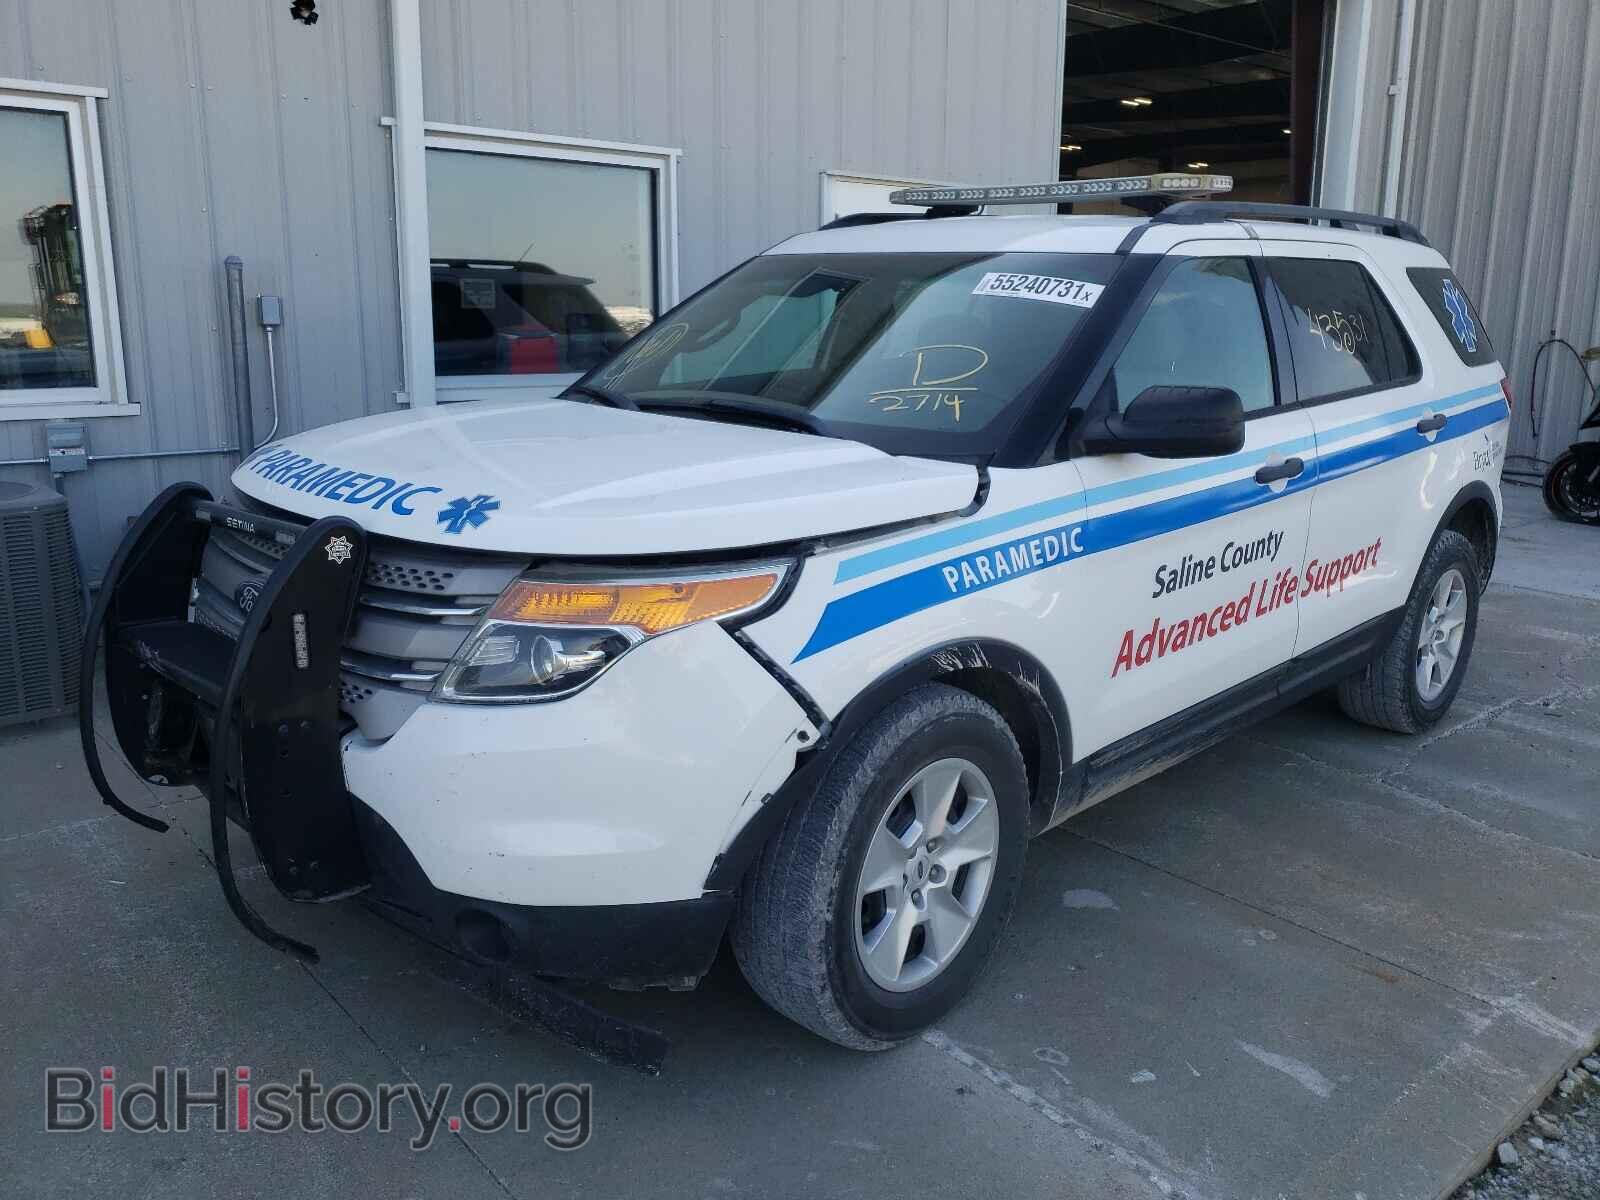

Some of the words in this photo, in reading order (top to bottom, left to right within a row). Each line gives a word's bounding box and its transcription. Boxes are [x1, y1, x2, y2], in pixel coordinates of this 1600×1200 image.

[249, 448, 442, 515] PARAMEDIC
[942, 527, 1084, 593] PARAMEDIC
[1152, 554, 1216, 599] Saline
[1220, 528, 1284, 574] County
[1111, 587, 1252, 679] Advanced
[1255, 568, 1298, 618] Life
[1301, 537, 1382, 598] Support
